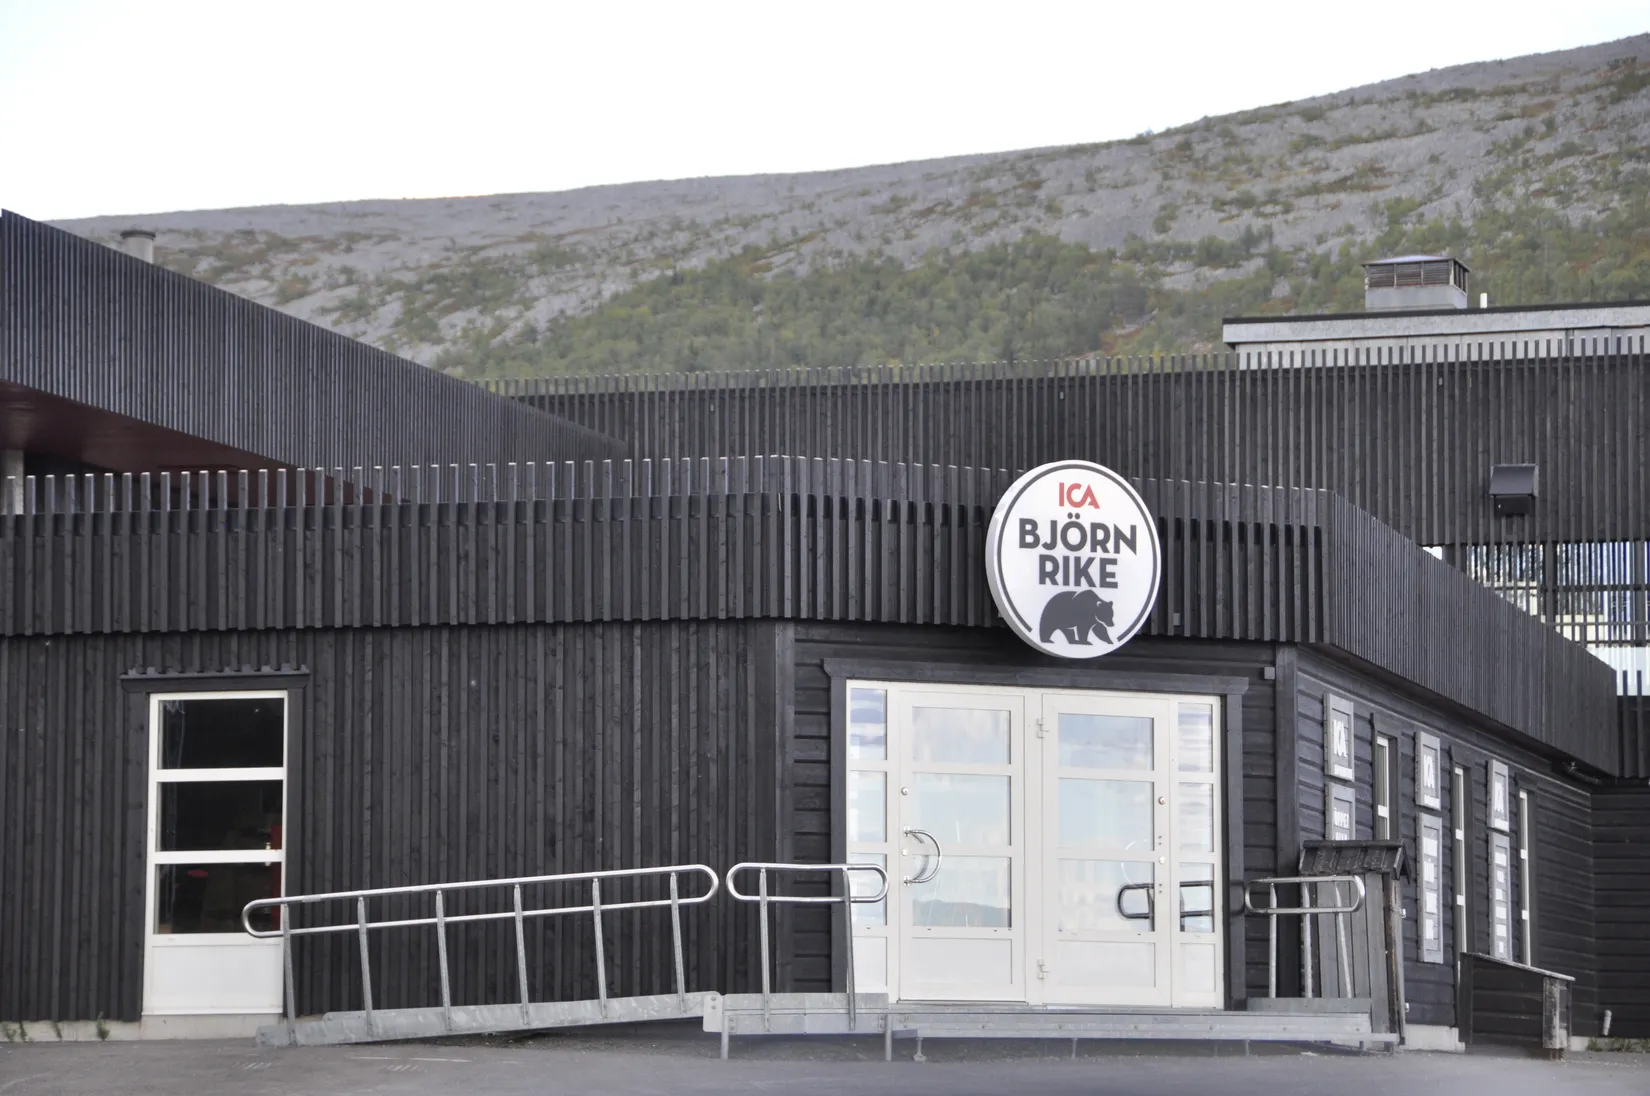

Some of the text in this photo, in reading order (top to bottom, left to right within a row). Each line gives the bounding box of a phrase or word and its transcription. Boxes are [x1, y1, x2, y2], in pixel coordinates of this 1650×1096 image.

[1058, 482, 1100, 509] ICA
[1019, 512, 1137, 555] BJÖRN
[1039, 554, 1118, 589] RIKE
